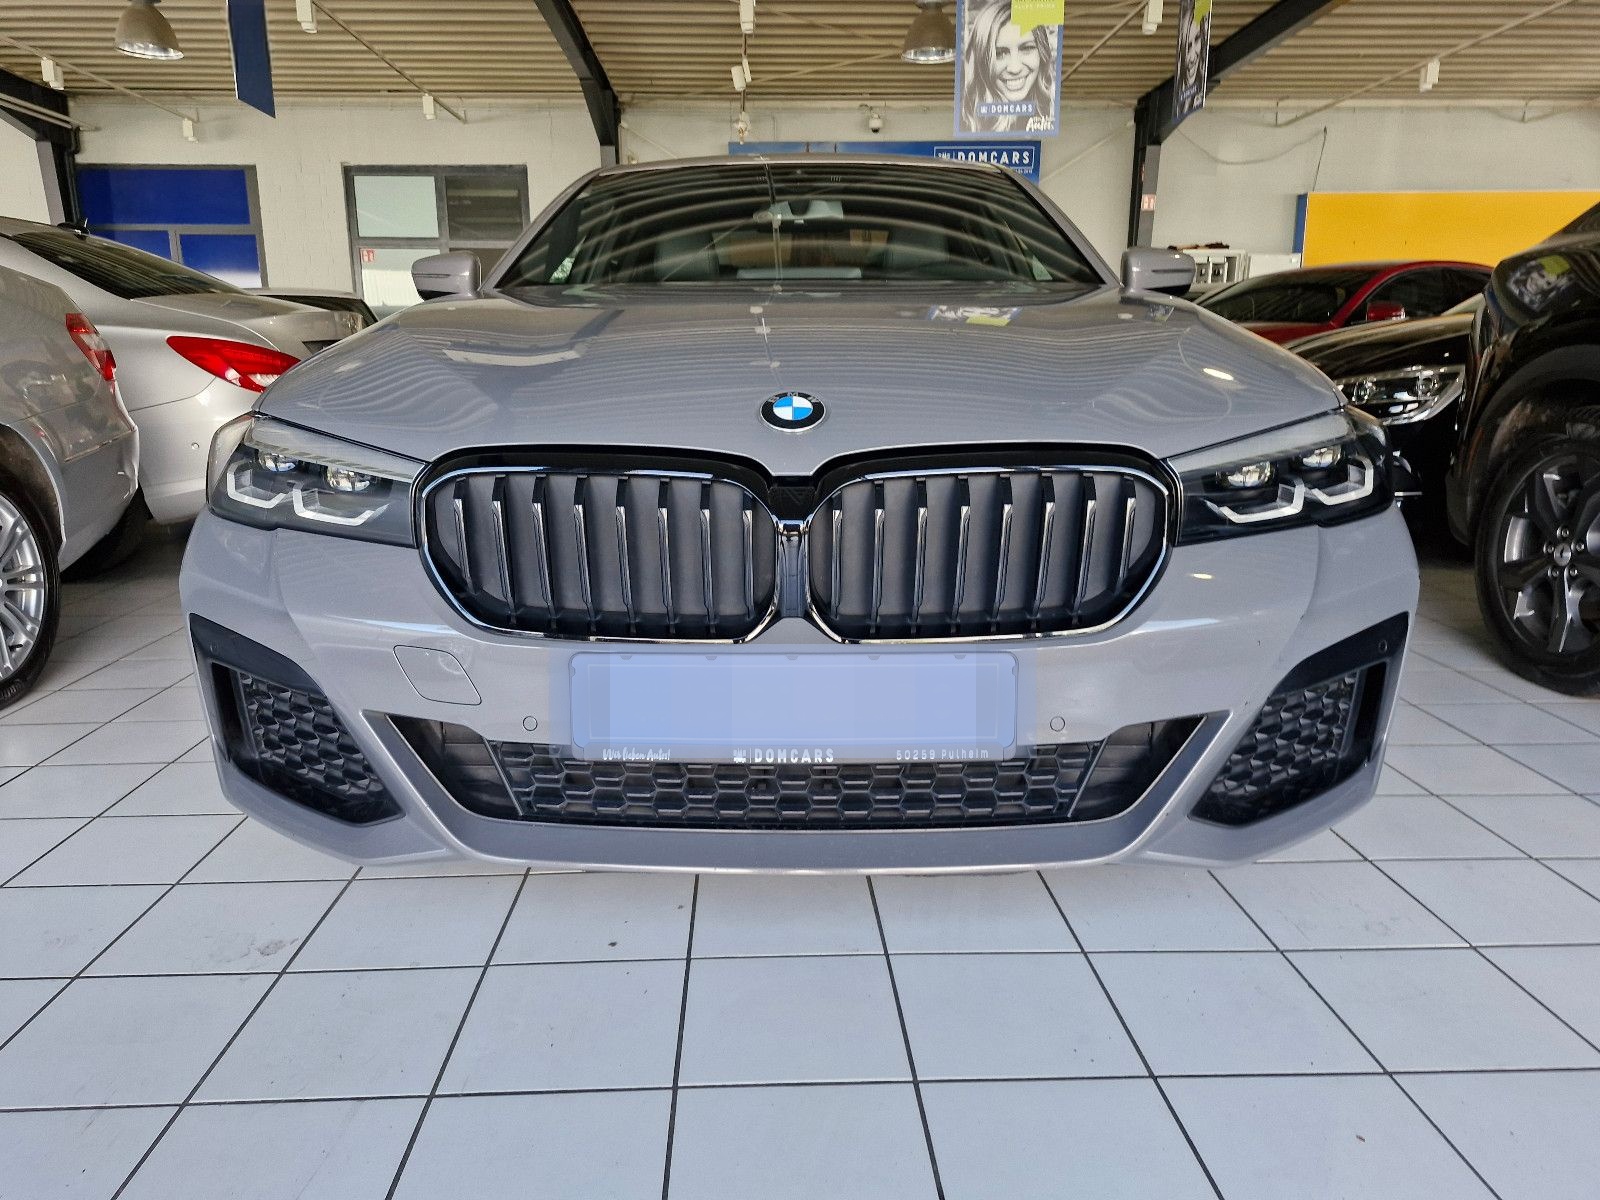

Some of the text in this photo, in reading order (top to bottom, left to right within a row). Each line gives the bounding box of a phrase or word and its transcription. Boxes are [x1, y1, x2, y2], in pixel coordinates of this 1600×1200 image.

[991, 103, 1033, 114] DOMCARS
[957, 150, 1030, 165] DOMCARS
[754, 748, 834, 763] DOMCARS
[941, 748, 989, 760] Pulheim
